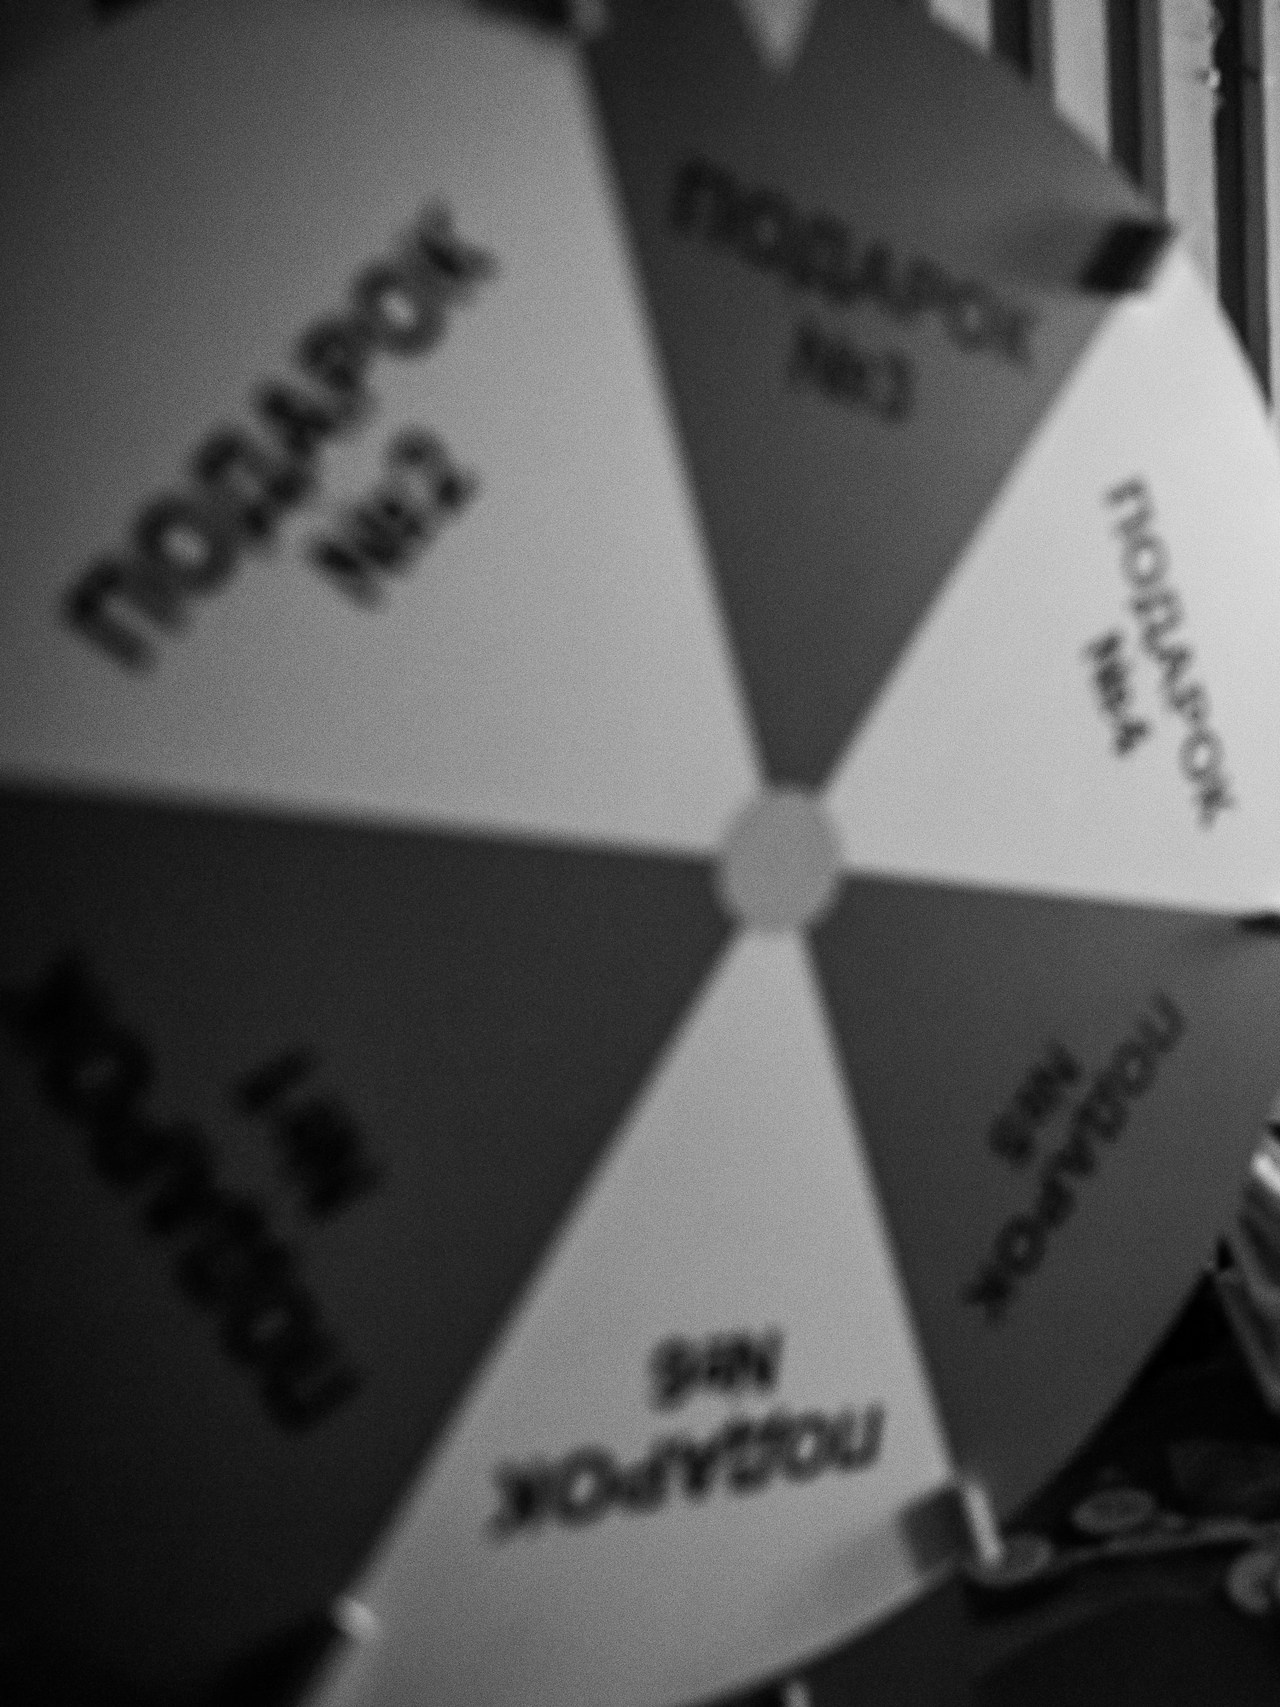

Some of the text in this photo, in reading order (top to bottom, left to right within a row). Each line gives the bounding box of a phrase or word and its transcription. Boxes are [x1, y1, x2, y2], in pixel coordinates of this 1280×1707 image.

[672, 158, 1035, 370] ПОДАРОК
[63, 202, 495, 670] ПОДАРОК
[310, 428, 478, 606] №2
[1085, 630, 1152, 757] №4
[1105, 478, 1236, 828] ПОДАРОК
[966, 992, 1184, 1326] ПОДАРОК
[488, 1402, 885, 1545] ПОДАРОК
